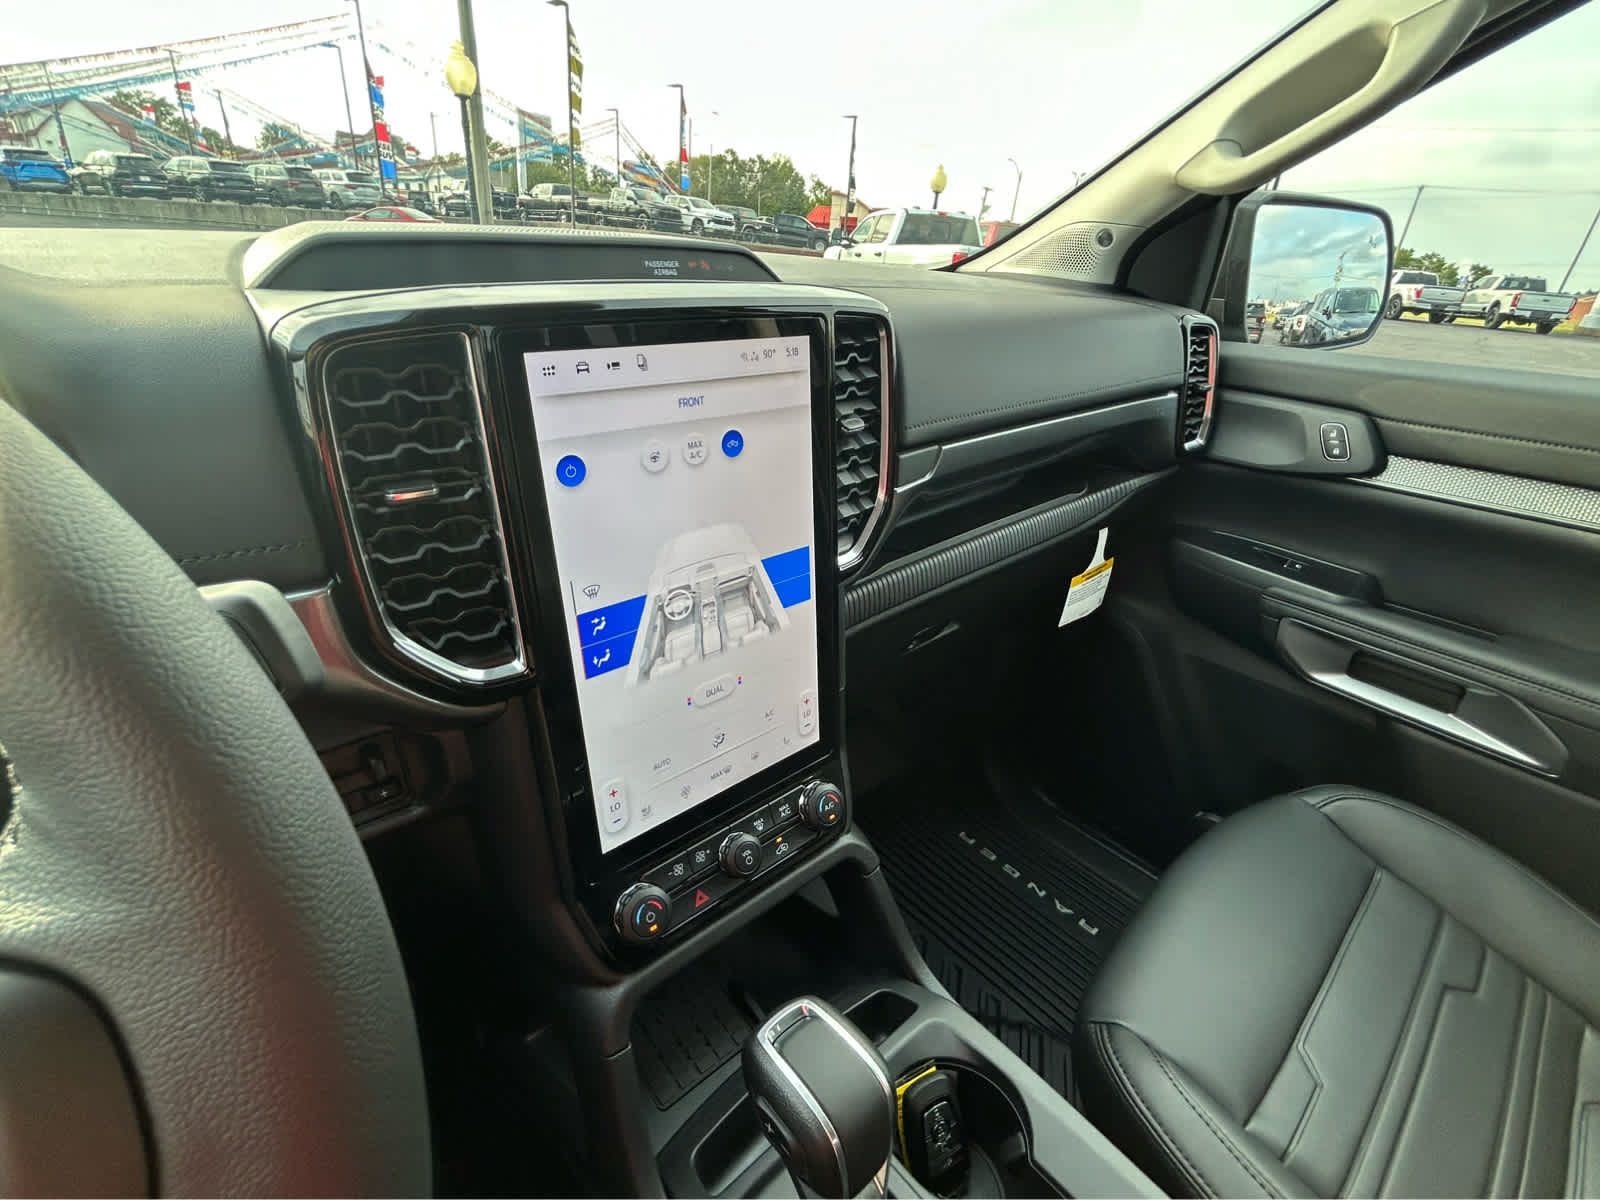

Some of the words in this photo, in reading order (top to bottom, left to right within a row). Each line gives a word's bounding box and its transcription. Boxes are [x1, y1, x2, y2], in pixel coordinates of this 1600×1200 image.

[678, 395, 704, 408] FRONT
[687, 441, 704, 449] MAX
[705, 684, 725, 698] DUAL
[653, 757, 672, 770] AUTO
[608, 801, 621, 813] LO
[959, 831, 1099, 935] RANGER
